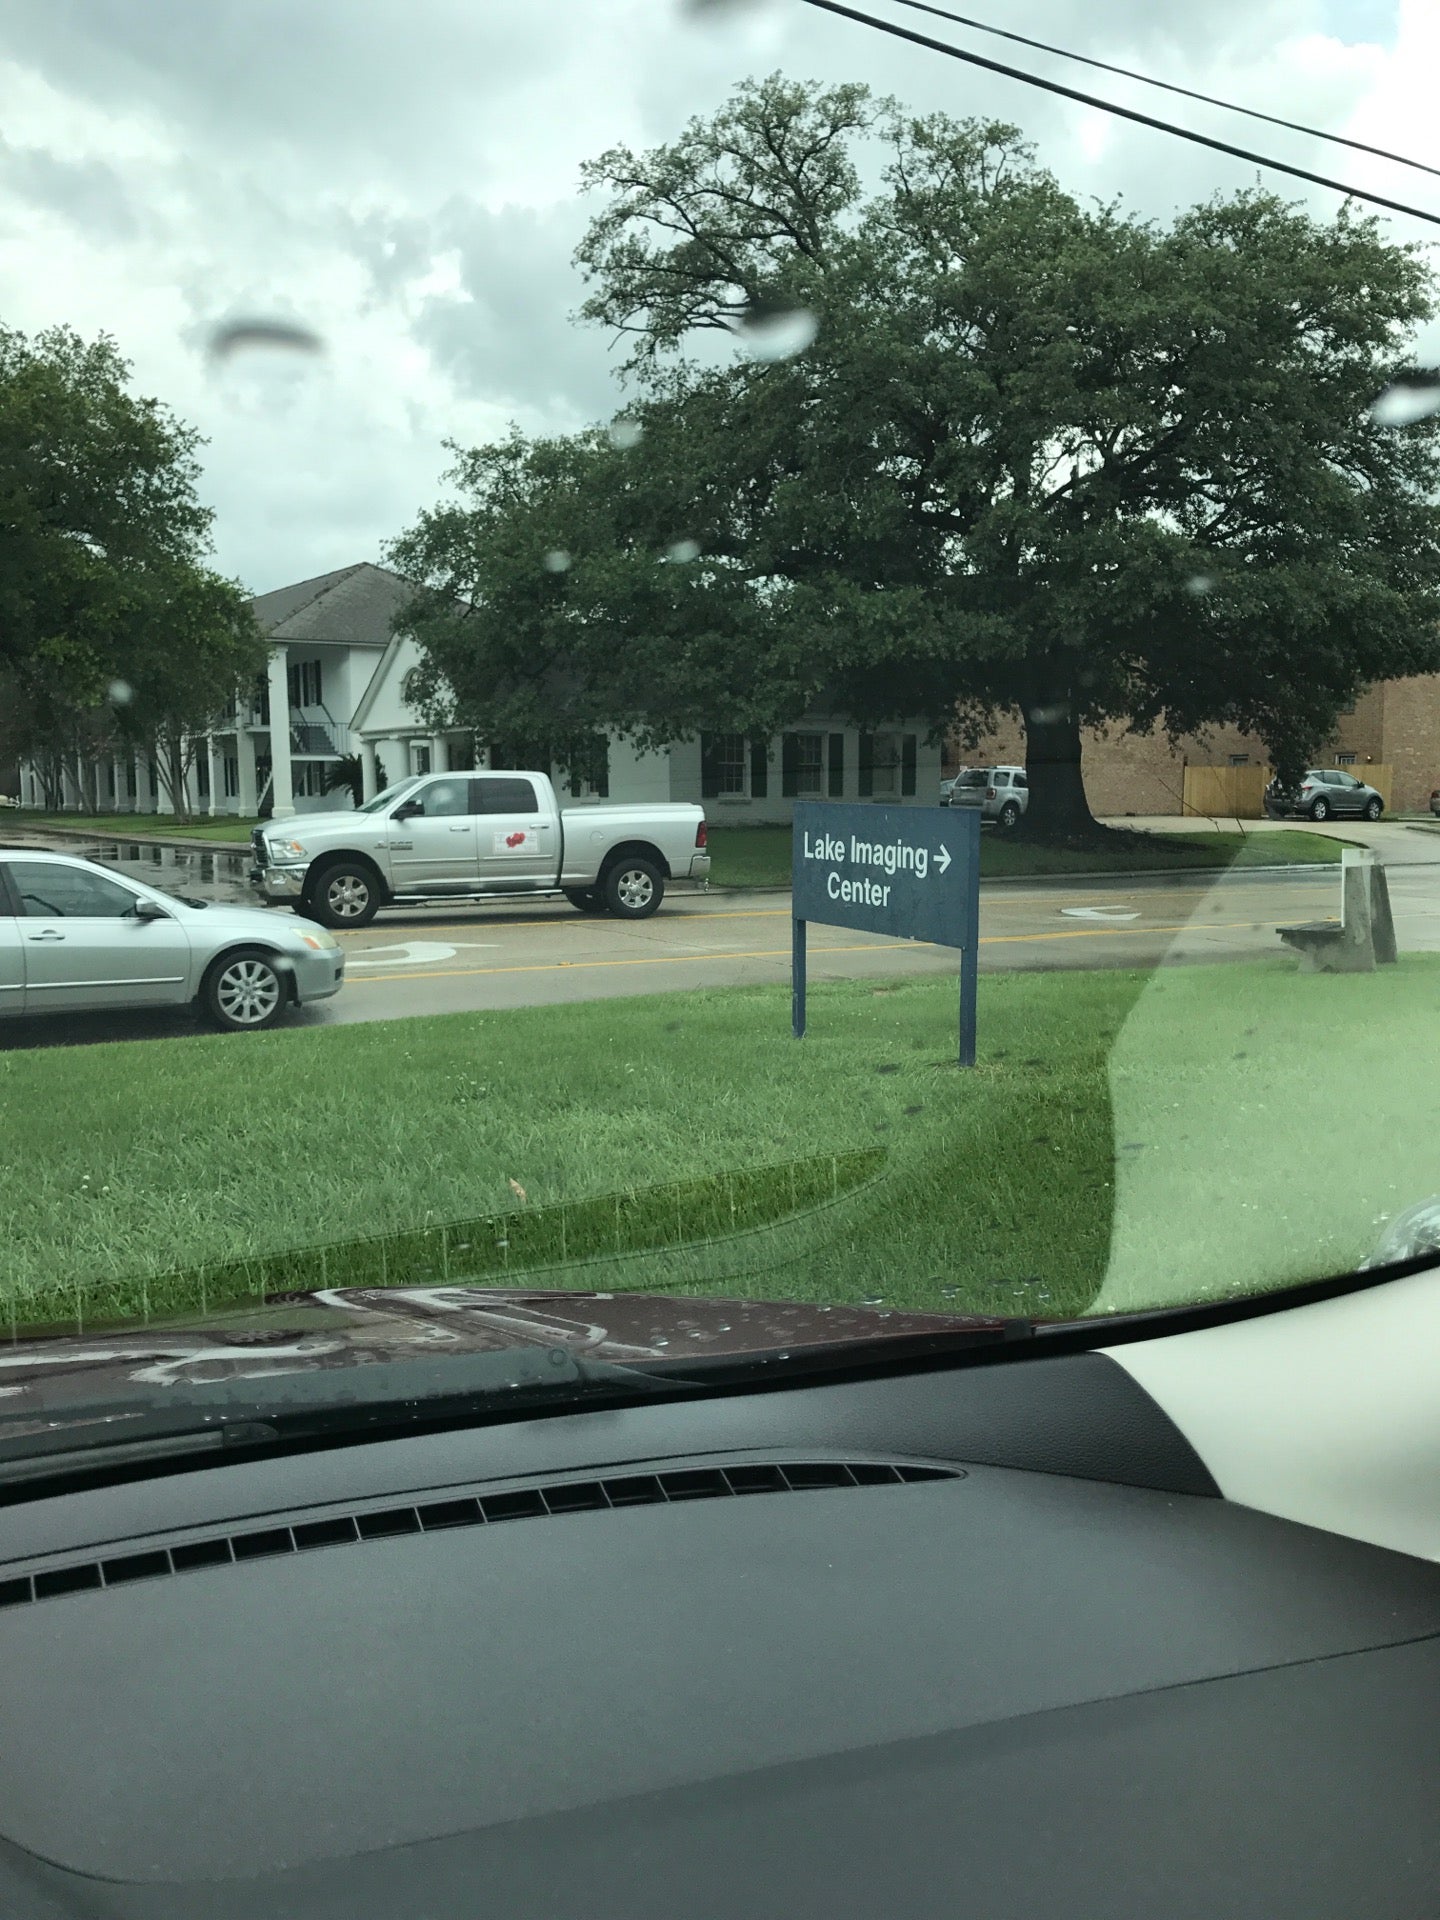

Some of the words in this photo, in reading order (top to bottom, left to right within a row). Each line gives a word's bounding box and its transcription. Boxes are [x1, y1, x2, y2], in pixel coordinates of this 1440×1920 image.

[804, 831, 845, 862] Lake
[851, 835, 928, 879] Imaging
[827, 871, 891, 907] Center
